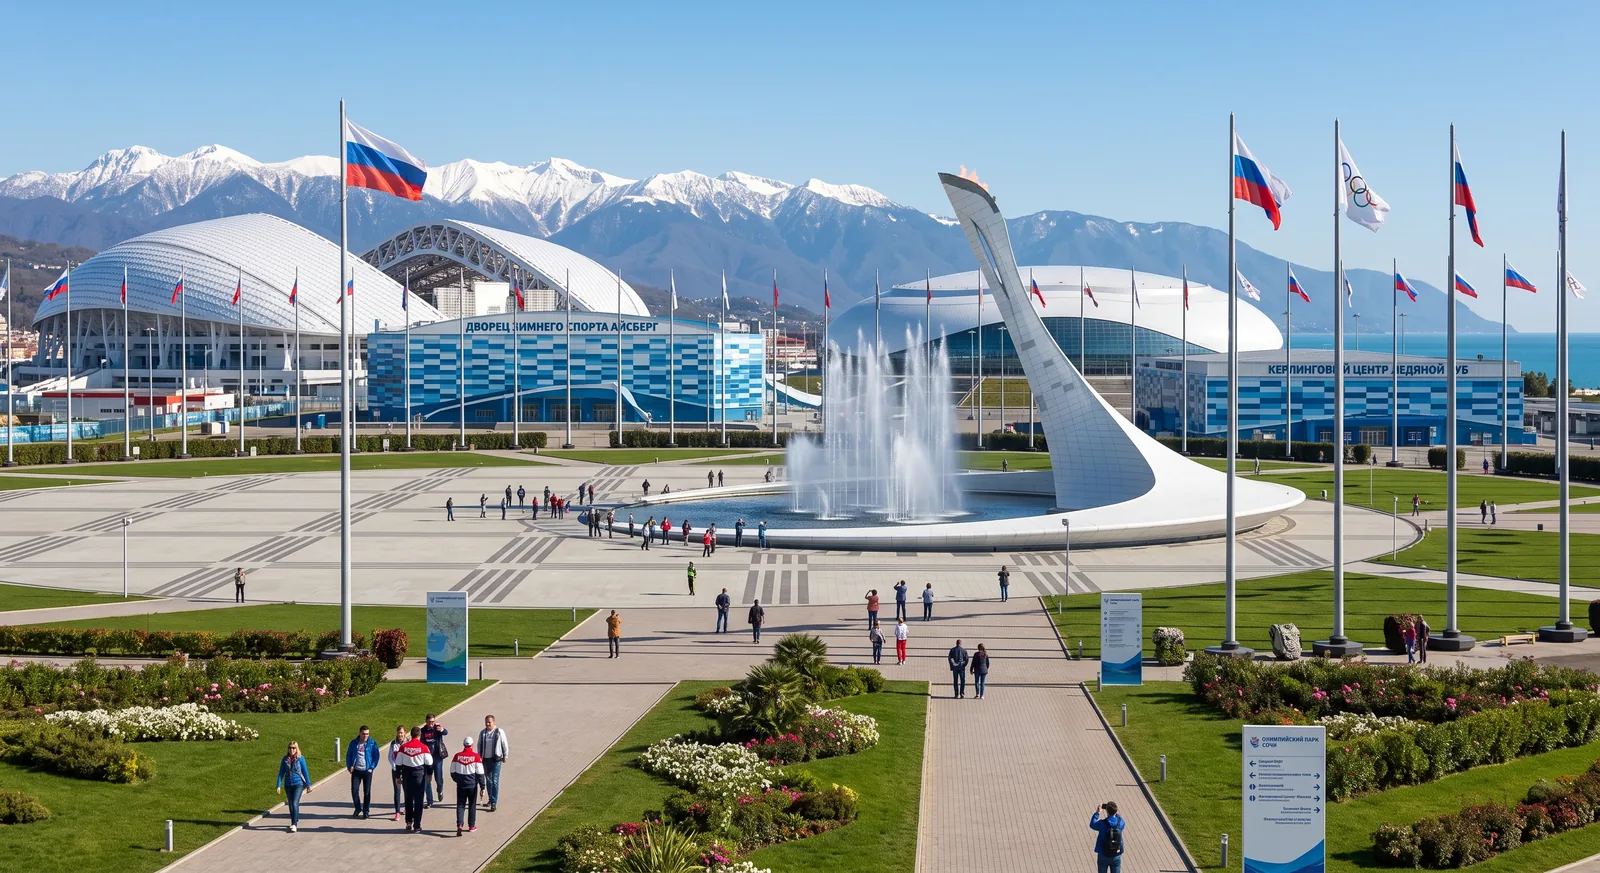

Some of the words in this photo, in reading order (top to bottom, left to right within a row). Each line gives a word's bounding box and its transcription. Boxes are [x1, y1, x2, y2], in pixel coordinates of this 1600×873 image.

[466, 322, 510, 333] ДВОРЕЦ
[610, 320, 659, 332] АЙСБЕРГ
[1268, 362, 1350, 374] КЕРЛИНГОВЙ
[1353, 365, 1389, 376] ЦЕНТР
